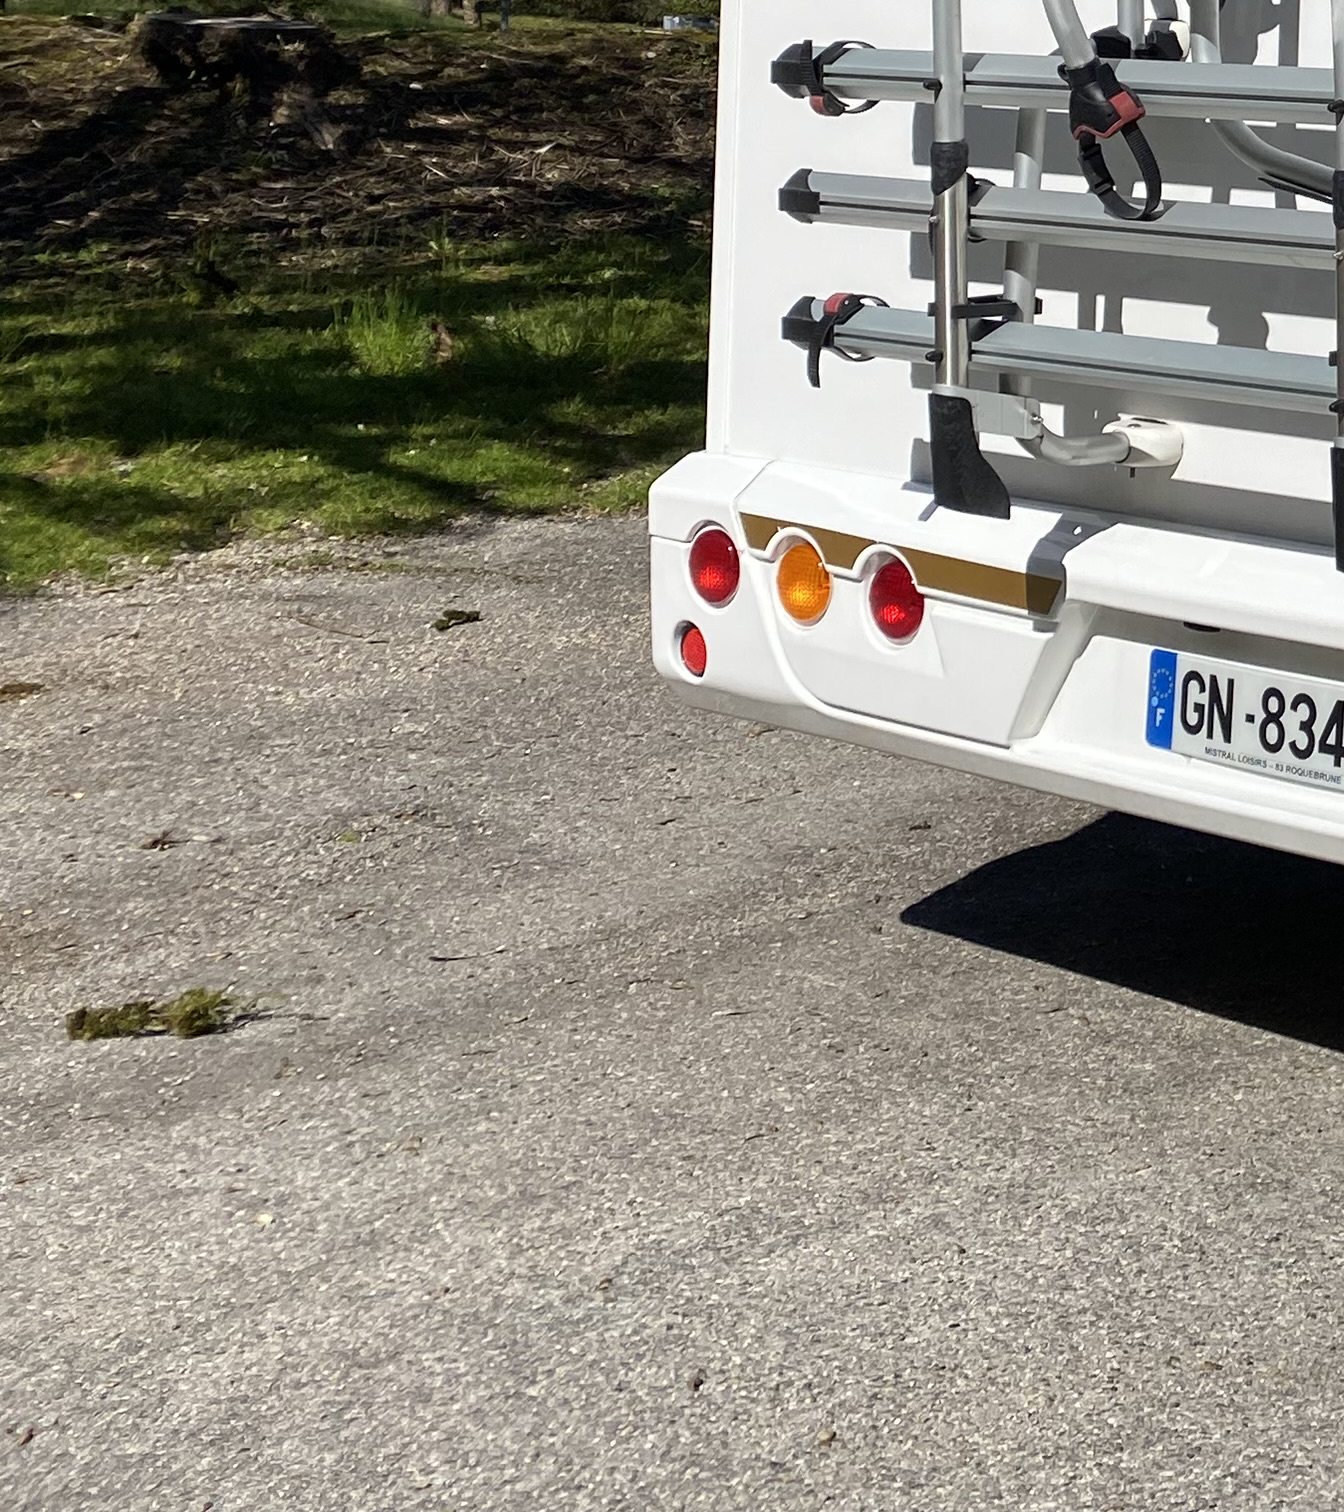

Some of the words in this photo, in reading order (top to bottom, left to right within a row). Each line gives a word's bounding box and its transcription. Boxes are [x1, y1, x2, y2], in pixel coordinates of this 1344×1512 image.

[1155, 706, 1166, 728] F
[1204, 746, 1236, 763] MISTRAL
[1237, 753, 1268, 769] LOISIRS
[1274, 762, 1284, 773] 83
[1285, 764, 1342, 785] ROQUEBRUNE
